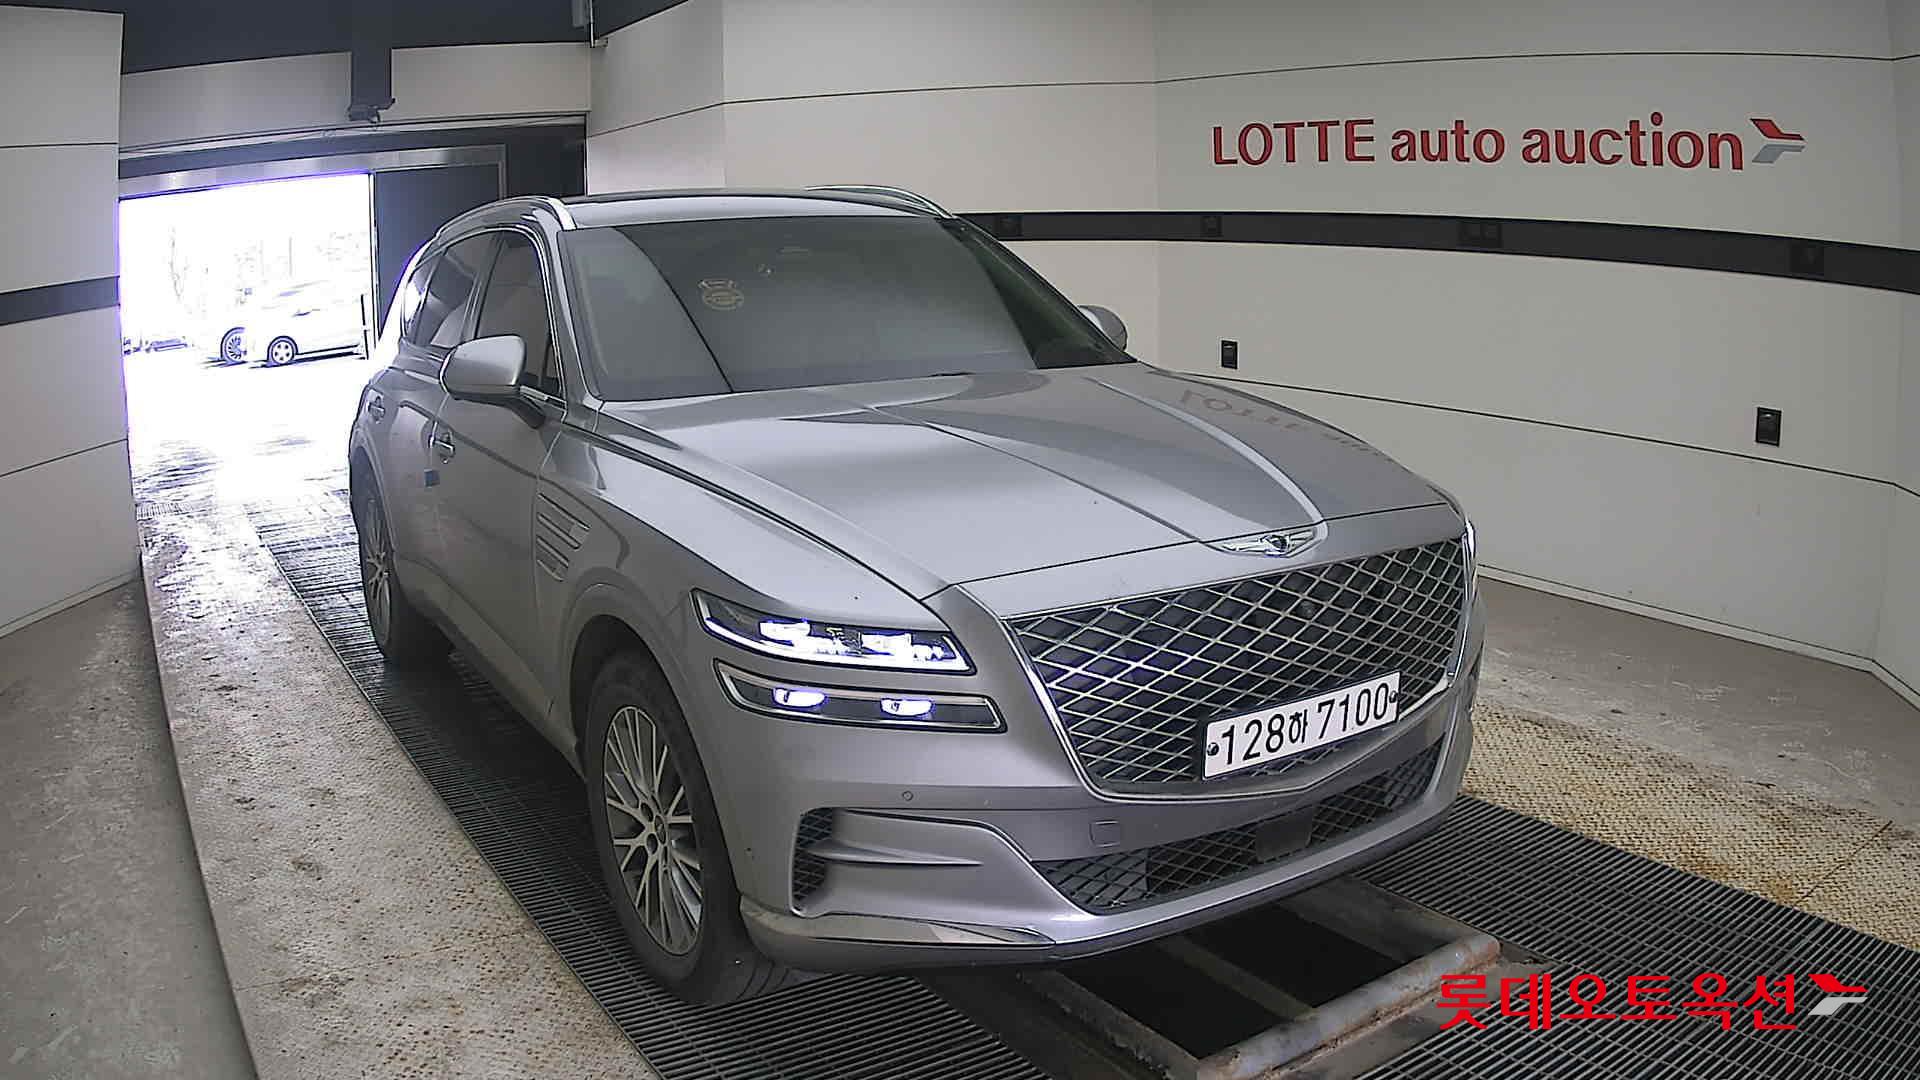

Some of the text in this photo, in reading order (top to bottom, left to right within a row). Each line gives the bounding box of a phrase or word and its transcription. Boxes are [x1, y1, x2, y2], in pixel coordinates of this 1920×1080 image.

[1213, 112, 1743, 170] LOTTE auto auction
[1222, 682, 1389, 765] 128하 7100
